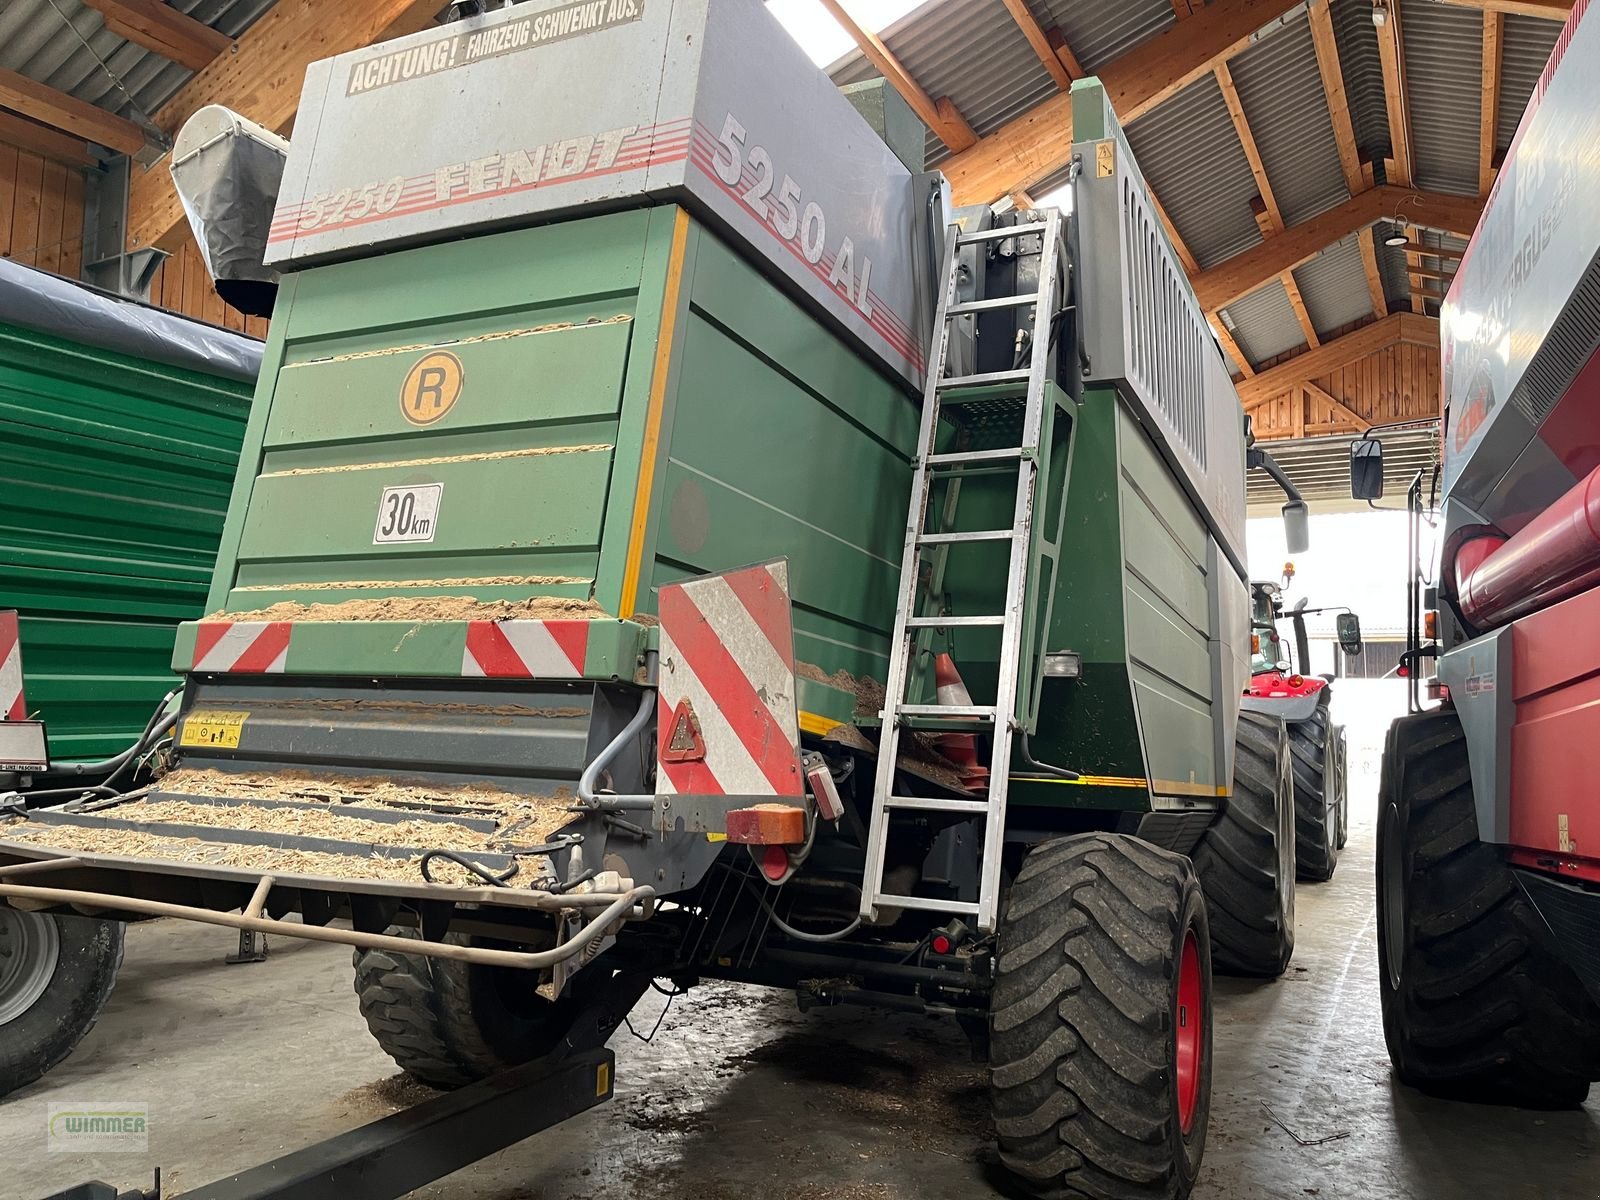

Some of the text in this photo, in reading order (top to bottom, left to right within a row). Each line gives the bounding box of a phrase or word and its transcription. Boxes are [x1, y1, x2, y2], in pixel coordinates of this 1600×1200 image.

[349, 37, 458, 94] ACHTUNG!
[466, 20, 531, 59] FAHRZEUG
[532, 1, 608, 43] SCHWENKT
[300, 124, 640, 230] 5250 FENDT
[712, 112, 875, 320] 5250 AL
[414, 367, 447, 410] R
